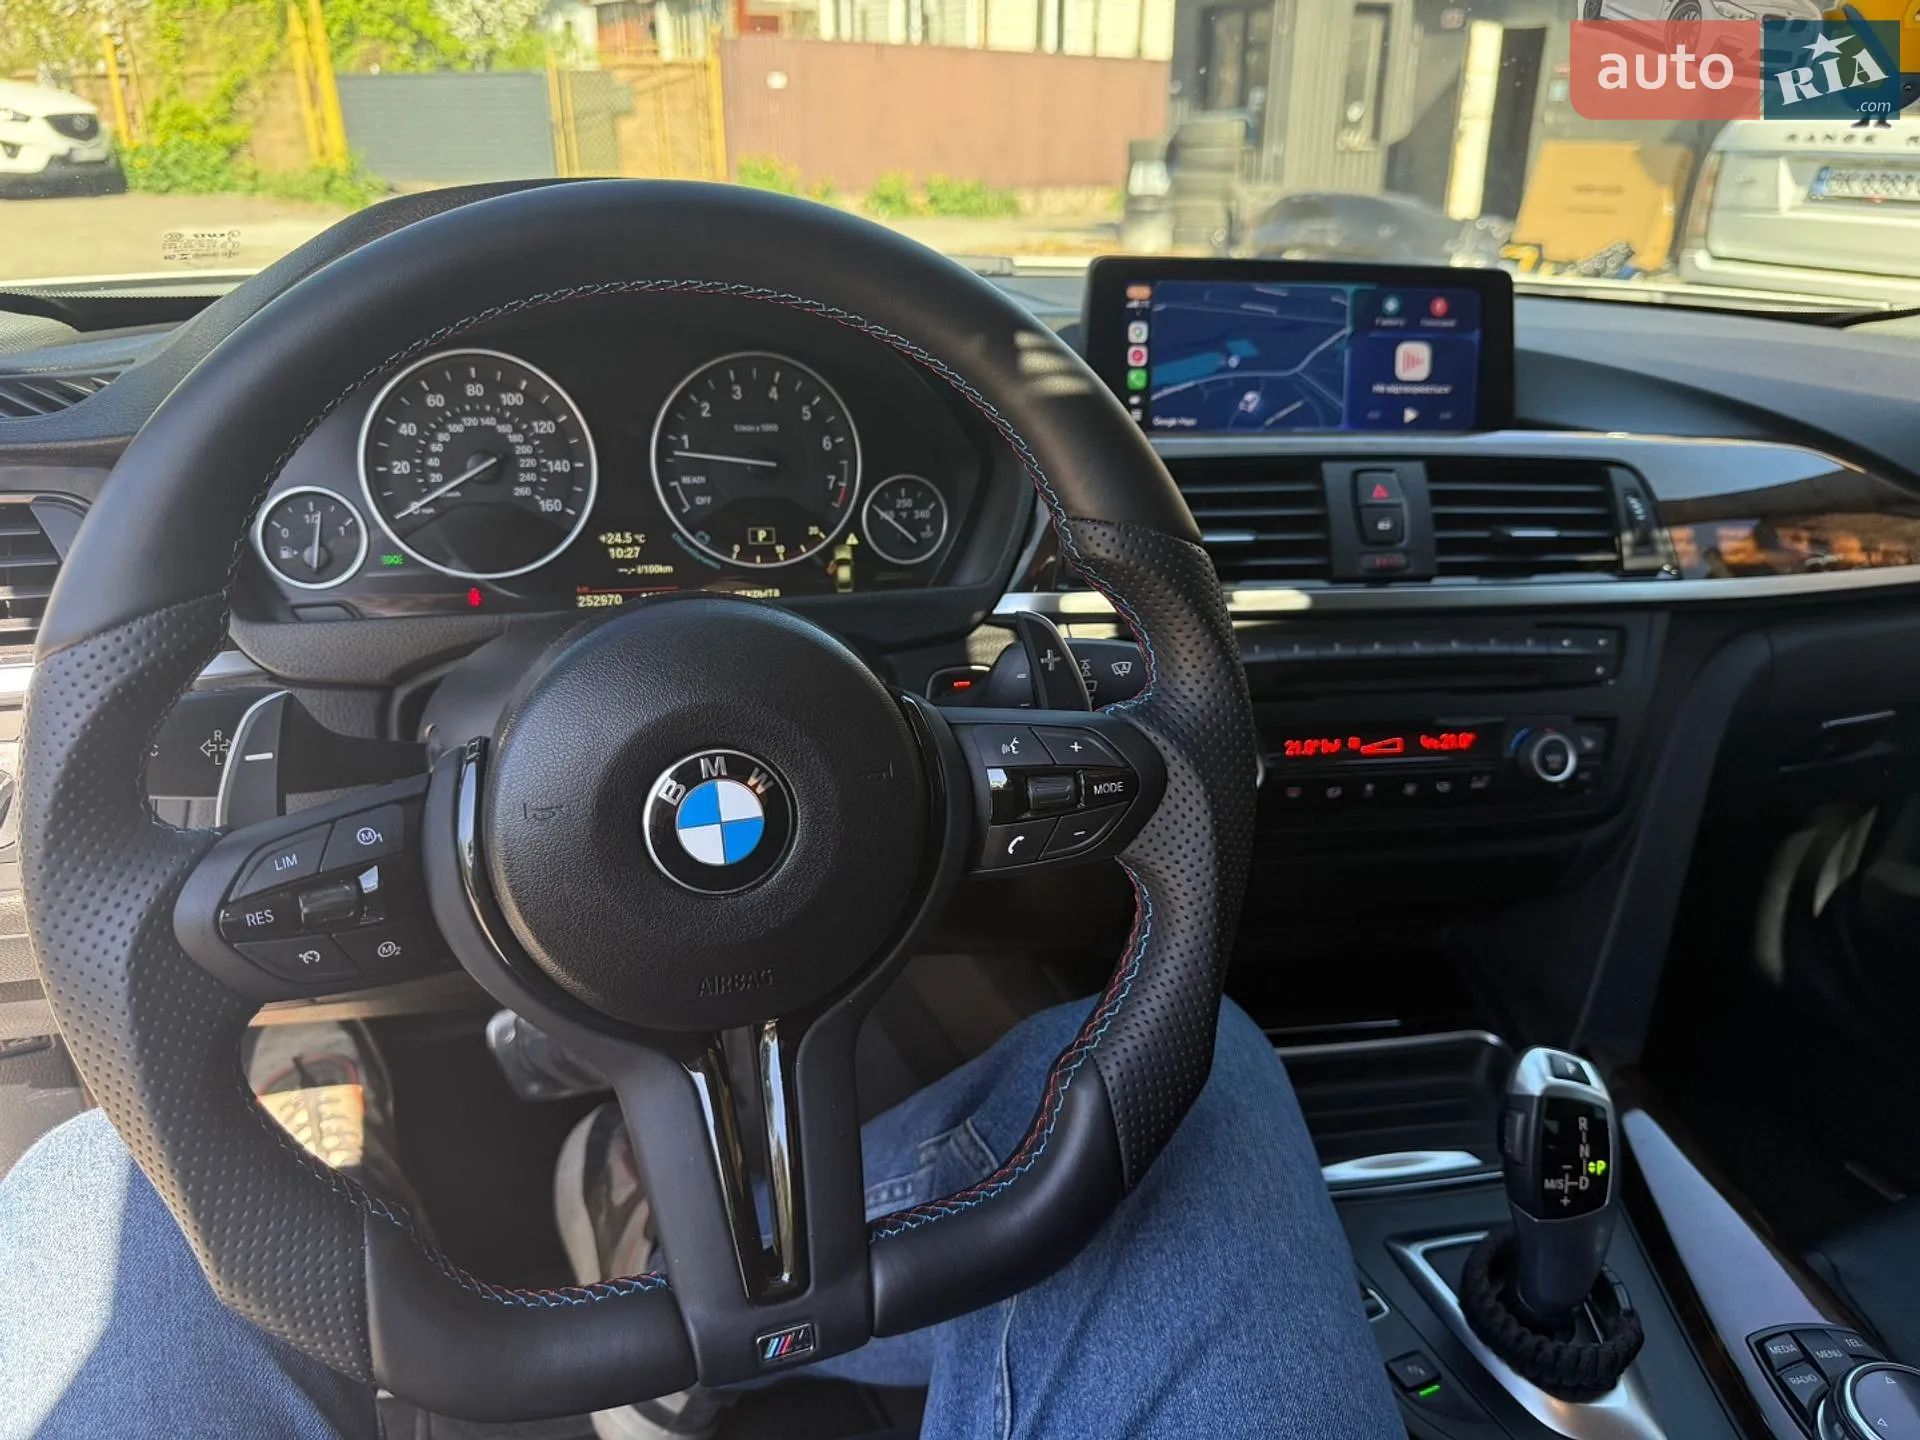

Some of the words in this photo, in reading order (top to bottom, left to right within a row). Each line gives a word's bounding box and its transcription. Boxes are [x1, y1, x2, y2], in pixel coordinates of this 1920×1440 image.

[466, 384, 484, 396] 80
[732, 387, 743, 400] 3
[769, 387, 779, 400] 4
[427, 395, 445, 407] 60
[501, 393, 524, 406] 100
[701, 402, 712, 417] 2
[802, 406, 812, 420] 5
[400, 423, 417, 436] 40
[532, 421, 556, 434] 120
[681, 434, 690, 449] 1
[822, 437, 832, 451] 6
[392, 461, 411, 474] 20
[427, 457, 441, 467] 40
[519, 458, 537, 467] 220
[547, 460, 571, 473] 140
[430, 473, 443, 483] 20
[827, 475, 836, 490] 7
[539, 499, 562, 512] 160
[695, 496, 712, 505] OFF
[281, 528, 289, 538] 0
[338, 526, 345, 536] 1
[757, 529, 767, 542] P
[599, 532, 633, 545] +24.5
[608, 546, 641, 560] 10:27
[577, 594, 623, 608] 252970
[214, 729, 223, 742] R
[214, 755, 223, 766] L
[658, 756, 774, 807] BMW
[1093, 782, 1125, 796] MODE
[274, 853, 298, 872] LIM
[245, 909, 275, 928] RES
[699, 968, 774, 998] AIRBAG
[1578, 1116, 1588, 1131] R
[1579, 1147, 1591, 1159] N
[1596, 1159, 1607, 1176] P
[1579, 1175, 1590, 1191] D
[1843, 1337, 1864, 1348] TEL
[1768, 1343, 1798, 1356] MEDIA
[1815, 1349, 1843, 1360] MENU
[1788, 1373, 1818, 1386] RADIO
